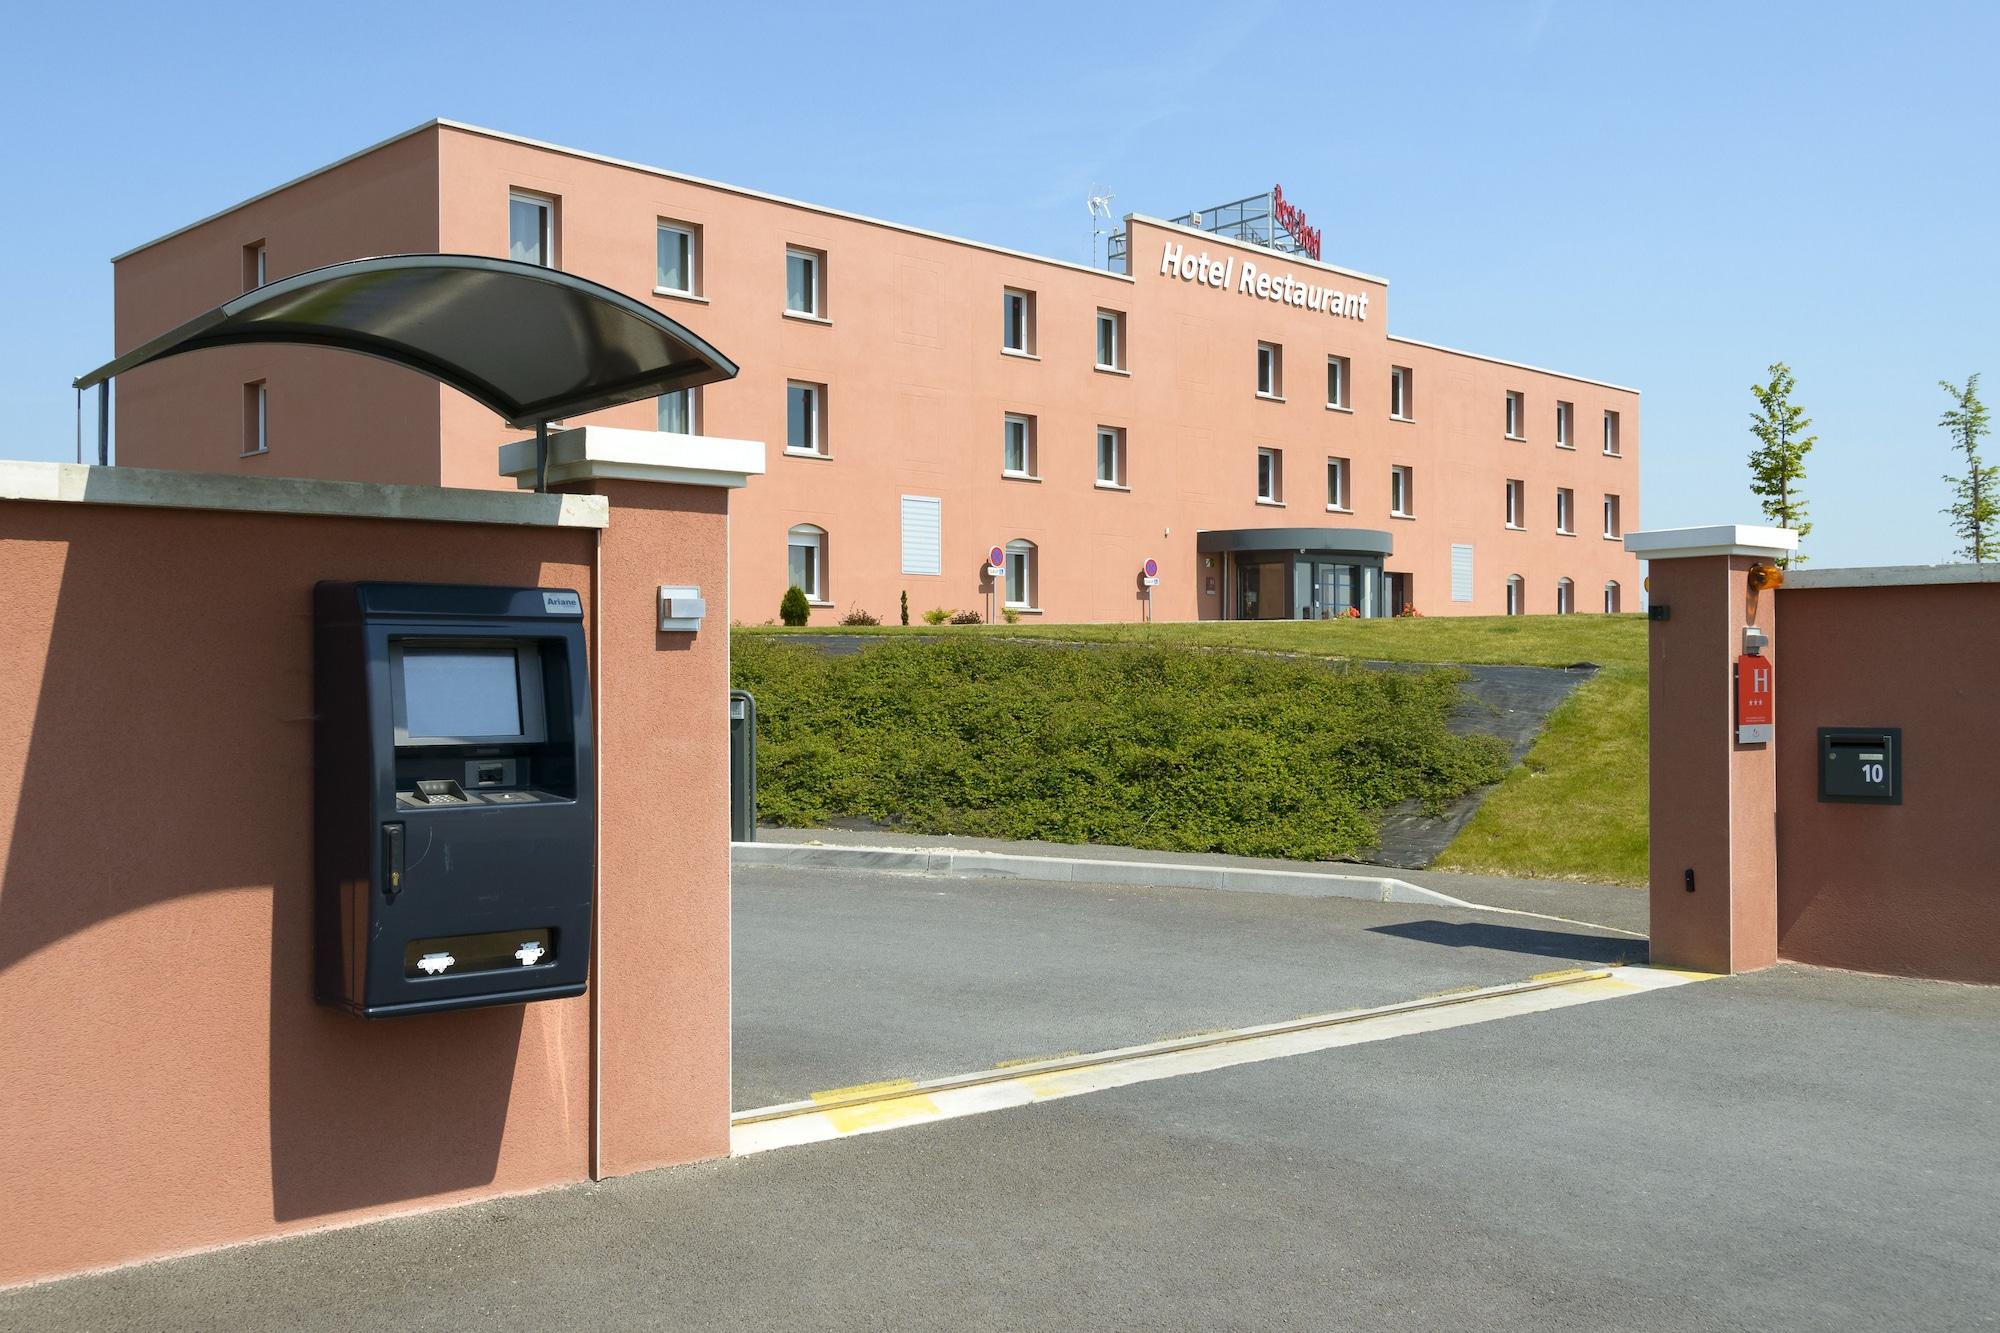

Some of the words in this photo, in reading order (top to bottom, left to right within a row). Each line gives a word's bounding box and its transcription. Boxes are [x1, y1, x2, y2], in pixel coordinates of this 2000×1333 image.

[1161, 241, 1234, 290] Hotel
[1238, 261, 1368, 321] Restaurant
[547, 598, 577, 606] Ariane
[1753, 668, 1768, 693] H
[1862, 764, 1883, 783] 10
